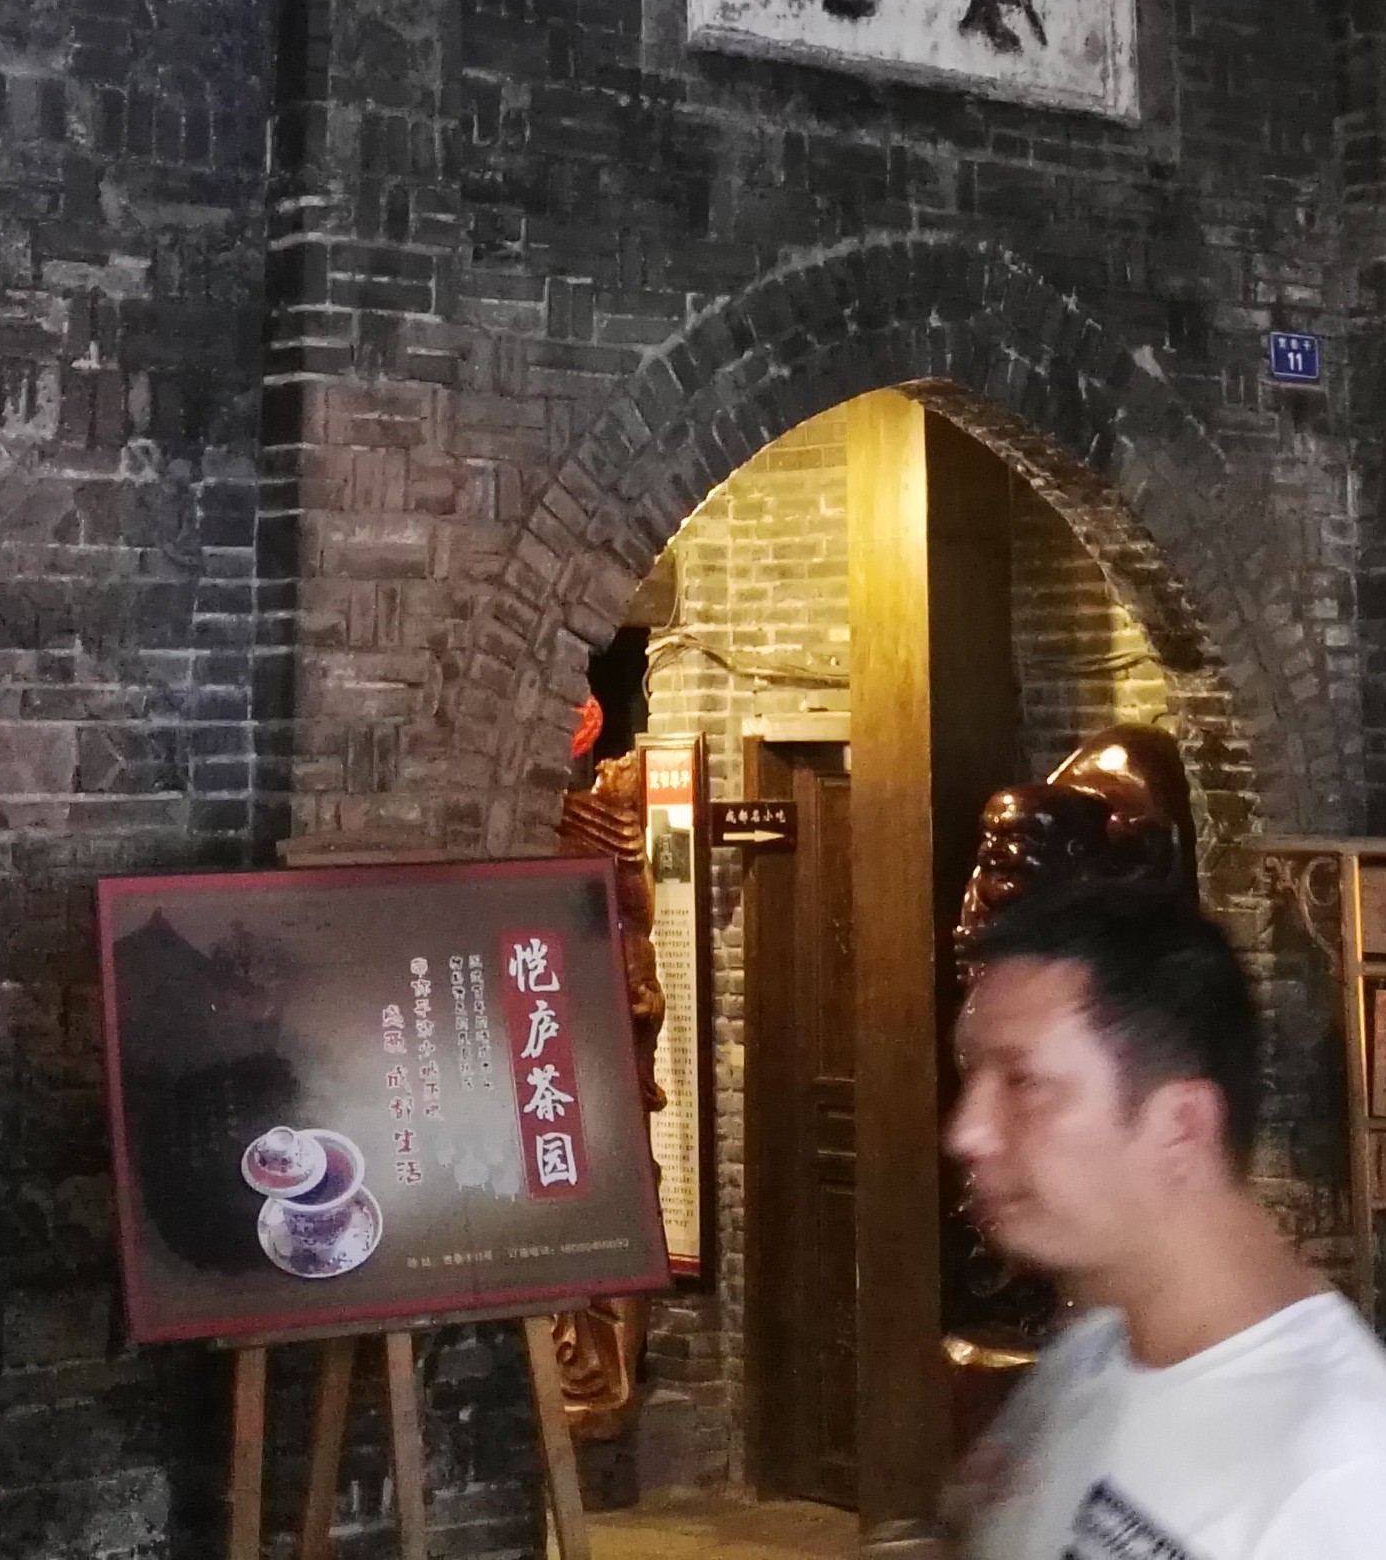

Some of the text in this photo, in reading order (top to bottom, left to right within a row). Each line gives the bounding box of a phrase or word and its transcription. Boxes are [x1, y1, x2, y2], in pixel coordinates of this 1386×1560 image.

[1287, 351, 1303, 371] 11
[508, 938, 580, 1187] 恺庐茶园
